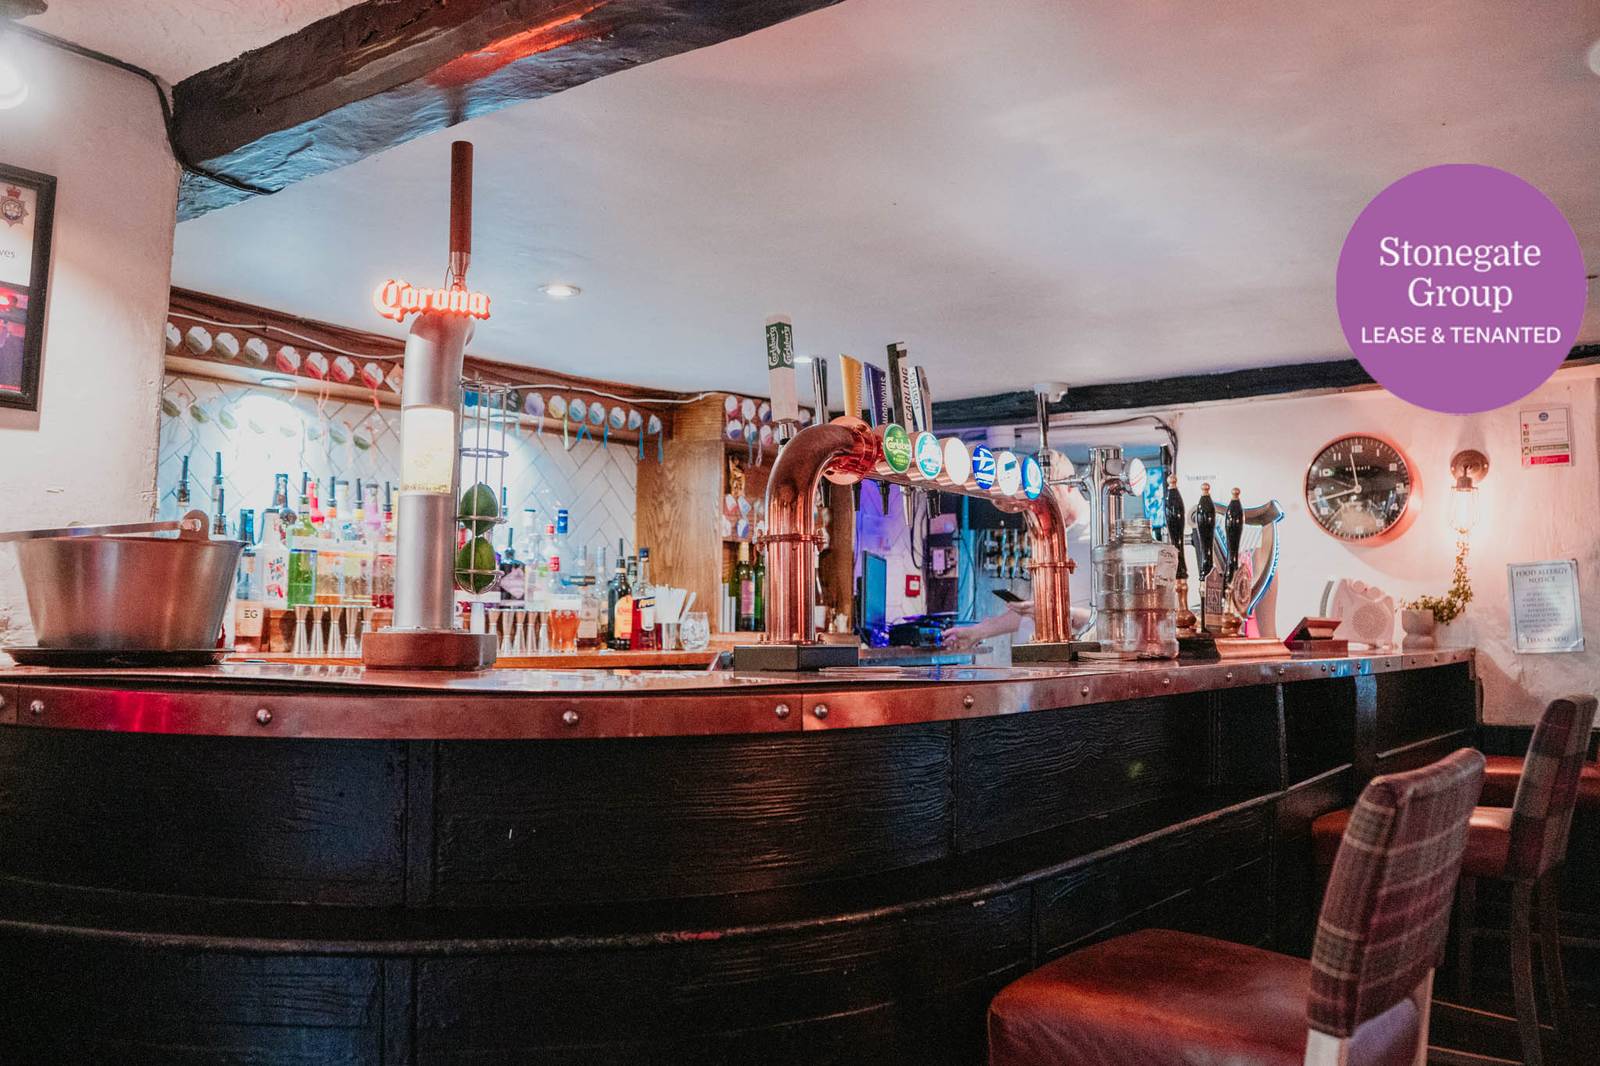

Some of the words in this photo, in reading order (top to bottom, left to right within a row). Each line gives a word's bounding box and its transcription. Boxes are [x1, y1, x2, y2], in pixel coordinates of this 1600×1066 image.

[372, 279, 491, 322] Corona
[768, 326, 780, 366] Carlsberg
[783, 326, 793, 365] Carlsberg
[901, 367, 912, 421] CARLING
[1333, 453, 1341, 461] 11
[244, 609, 258, 619] EG
